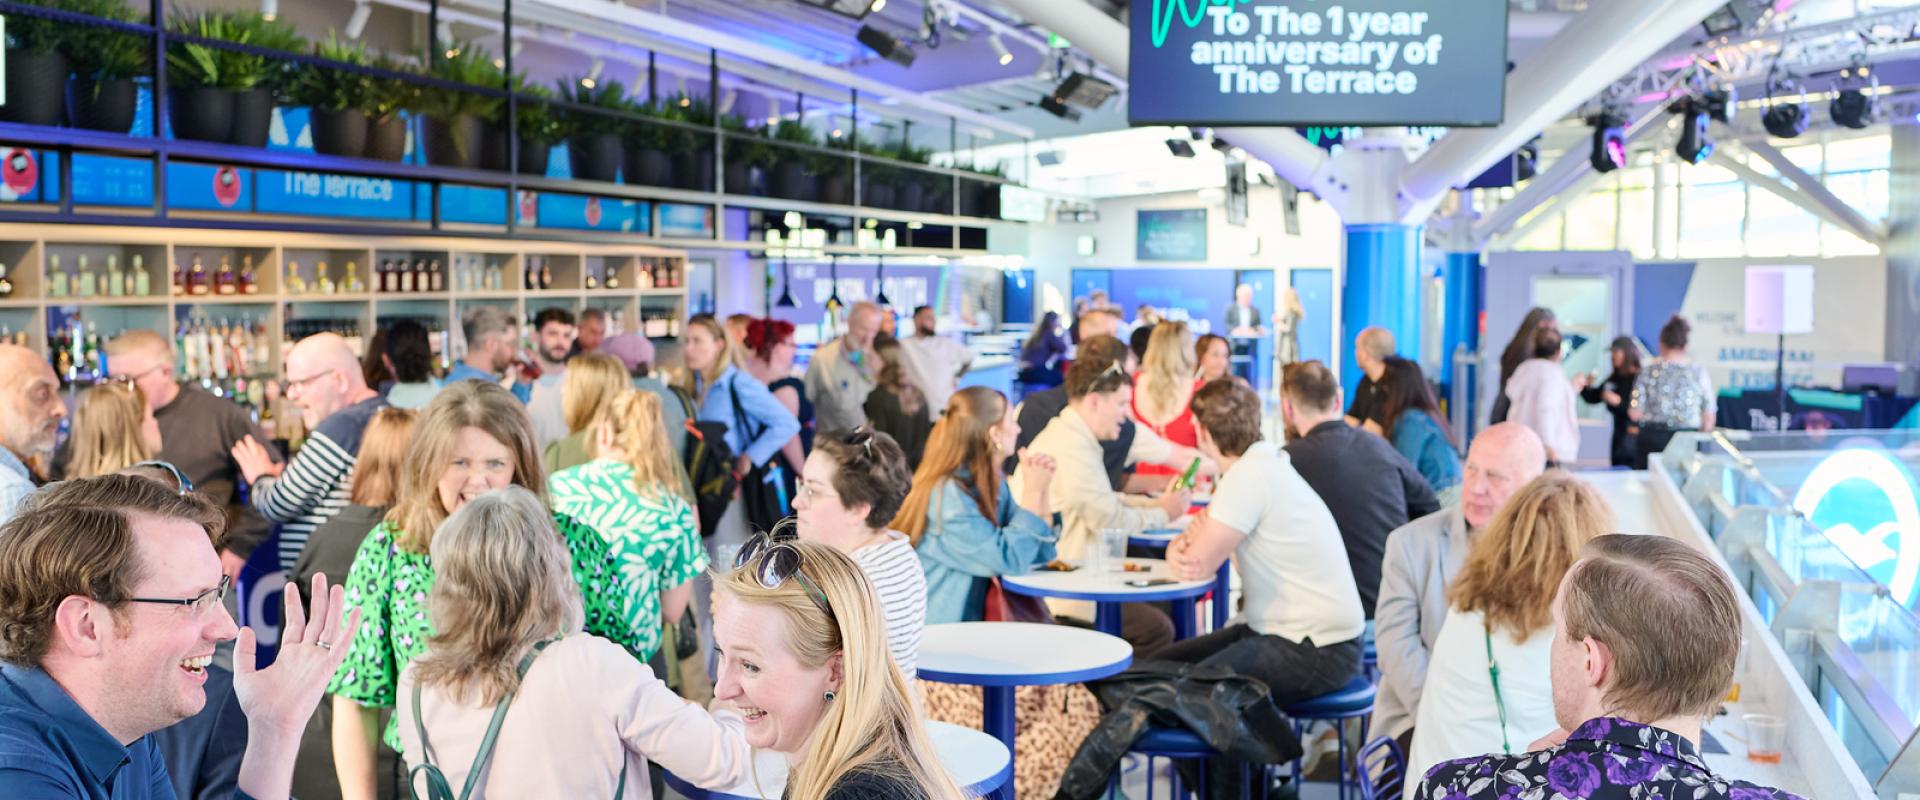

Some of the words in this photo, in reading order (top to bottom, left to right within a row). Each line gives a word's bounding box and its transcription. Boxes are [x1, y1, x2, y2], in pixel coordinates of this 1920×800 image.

[1207, 6, 1250, 35] To
[1254, 6, 1322, 35] The
[1328, 6, 1344, 35] 1
[1348, 11, 1428, 42] year
[1191, 35, 1399, 69] anniversary
[1402, 34, 1443, 65] of
[1213, 65, 1280, 93] The
[1284, 65, 1417, 94] Terrace
